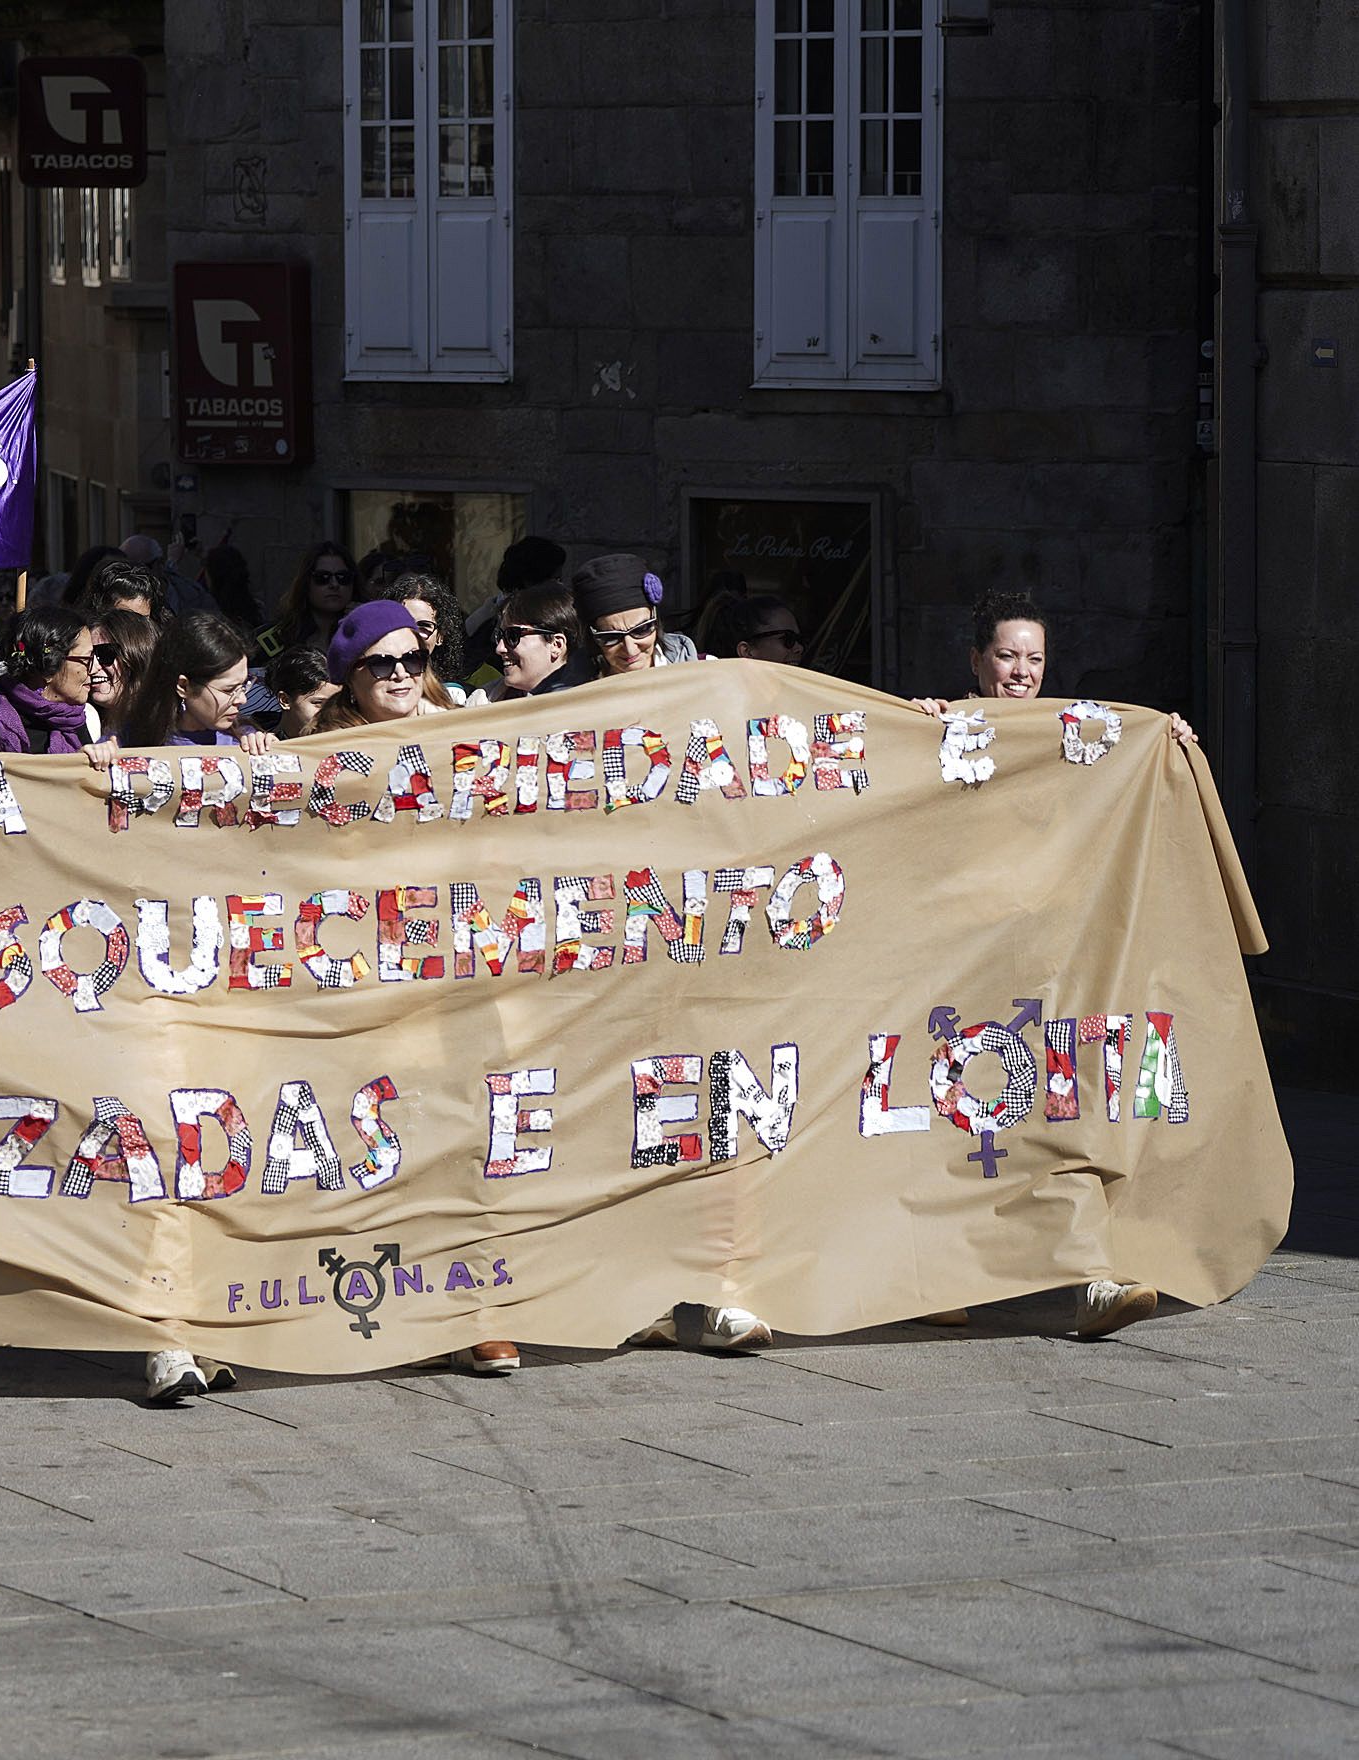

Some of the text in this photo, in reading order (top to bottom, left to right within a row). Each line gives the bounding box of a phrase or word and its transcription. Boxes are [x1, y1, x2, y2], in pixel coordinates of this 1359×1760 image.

[30, 153, 135, 169] TABACOS
[185, 398, 283, 416] TABACOS
[725, 535, 854, 560] La Palma Real
[106, 709, 872, 833] PRECARIEDADE
[938, 708, 997, 785] E
[482, 1067, 557, 1179] E
[630, 1042, 799, 1170] EN
[859, 1011, 1190, 1139] LOITA
